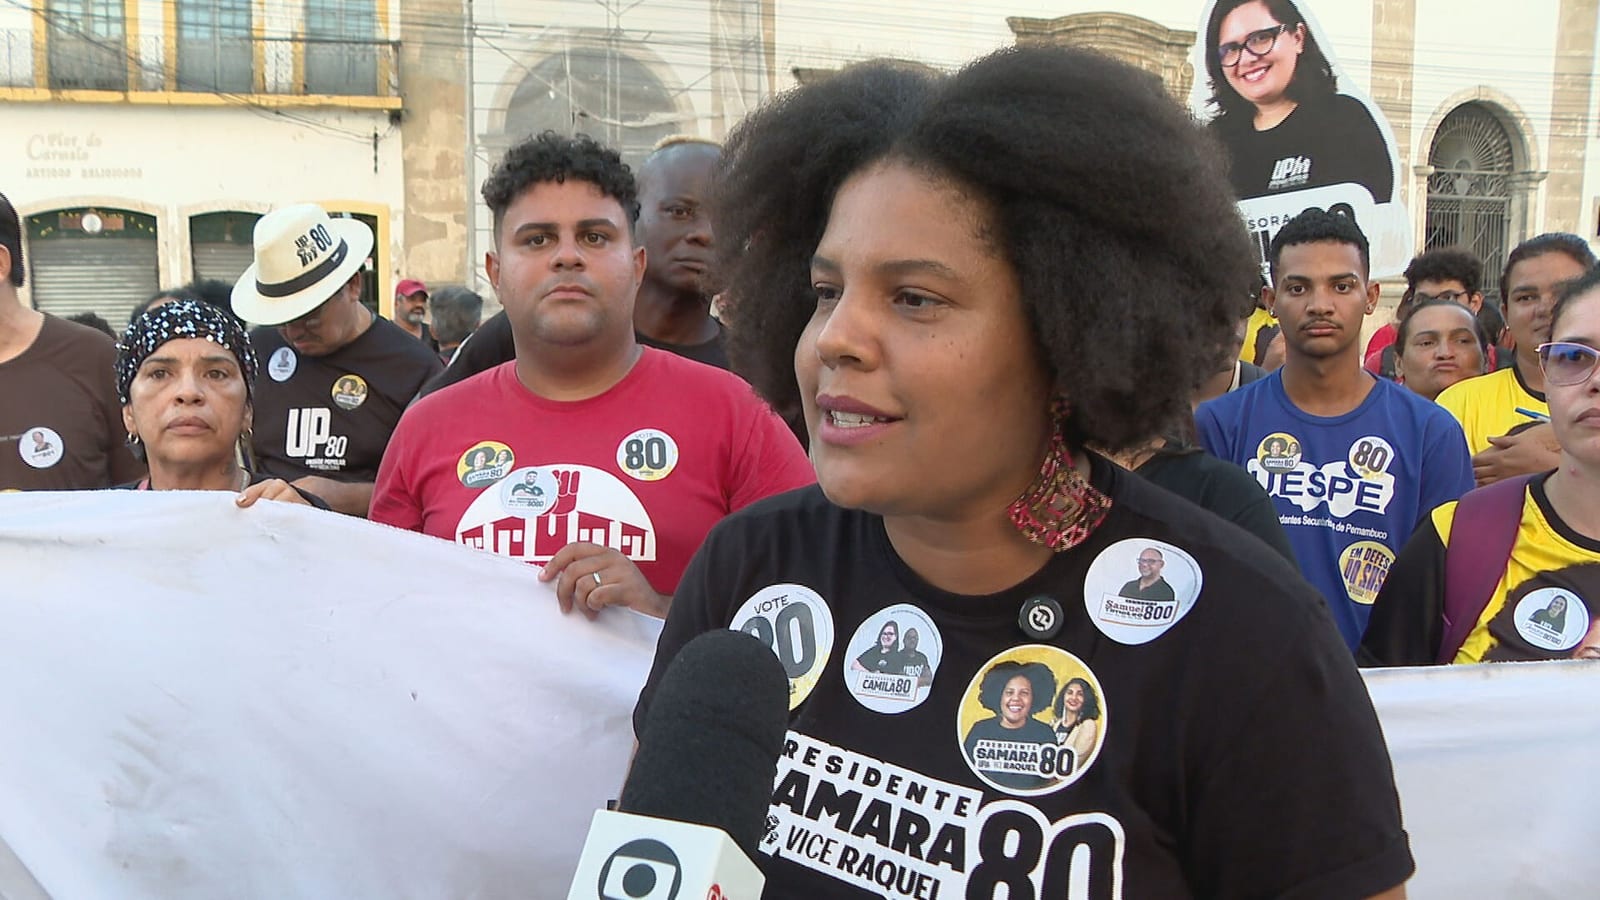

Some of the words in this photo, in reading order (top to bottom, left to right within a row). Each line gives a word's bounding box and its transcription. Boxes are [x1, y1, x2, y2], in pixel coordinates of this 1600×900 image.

[1247, 214, 1291, 230] SORA
[309, 223, 332, 252] 80
[286, 408, 331, 457] UP
[324, 436, 348, 457] 80
[625, 437, 667, 470] 80
[1354, 440, 1388, 473] 80
[1279, 514, 1301, 525] dentes
[1346, 523, 1388, 540] Pernambuco
[1350, 547, 1363, 558] EM
[1363, 547, 1391, 569] DEFES
[753, 594, 789, 615] VOTE
[1106, 599, 1144, 613] Samuel
[1143, 605, 1173, 620] 800
[862, 679, 896, 693] CAMILA
[896, 678, 911, 693] 80
[980, 741, 1036, 751] PRESIDENTE
[976, 748, 1038, 763] SAMARA
[1039, 746, 1074, 776] 80
[1003, 762, 1037, 772] RAQUEL
[781, 739, 971, 817] RESIDENTE
[771, 768, 966, 874] AMARA
[965, 809, 1116, 900] 80
[786, 825, 839, 865] VICE
